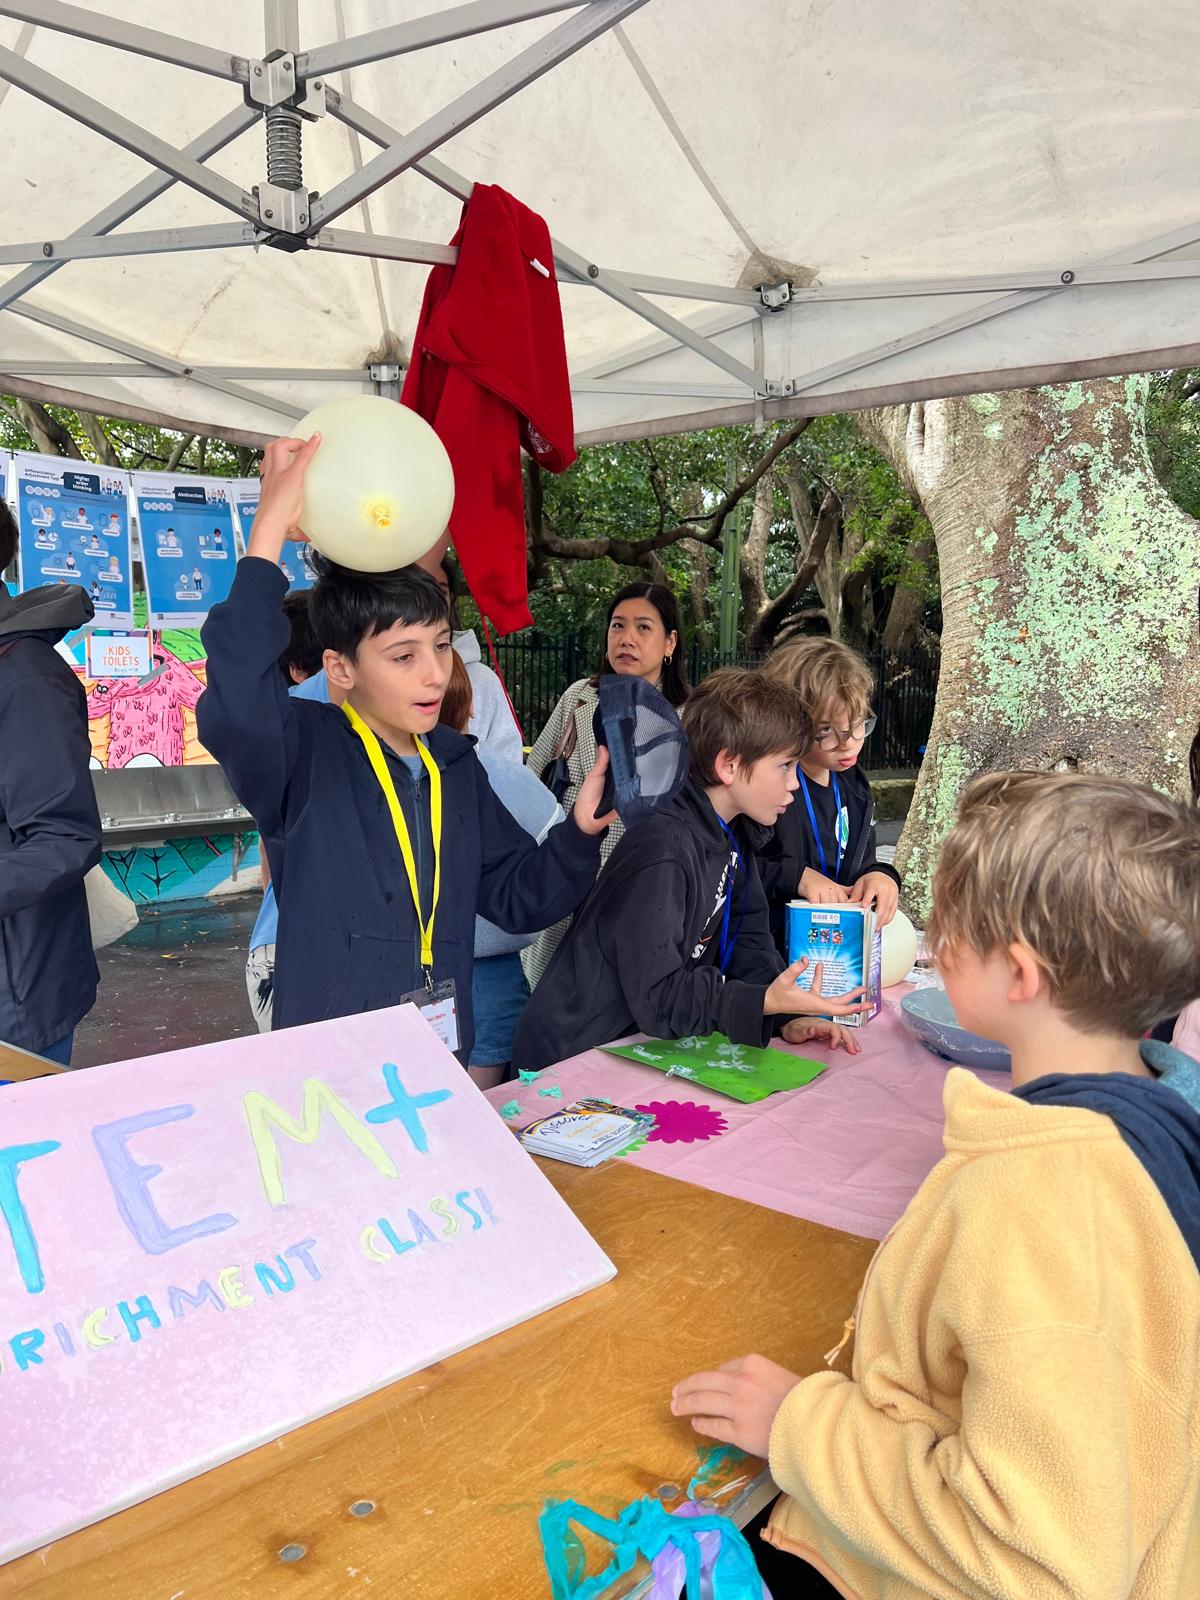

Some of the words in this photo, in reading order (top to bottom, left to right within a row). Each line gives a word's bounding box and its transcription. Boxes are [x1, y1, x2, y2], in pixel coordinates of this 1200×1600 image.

[72, 484, 92, 492] thinking
[108, 646, 131, 656] KIDS
[103, 656, 140, 666] TOILETS
[0, 1238, 322, 1375] RICHMENT
[360, 1187, 498, 1264] CLASS!
